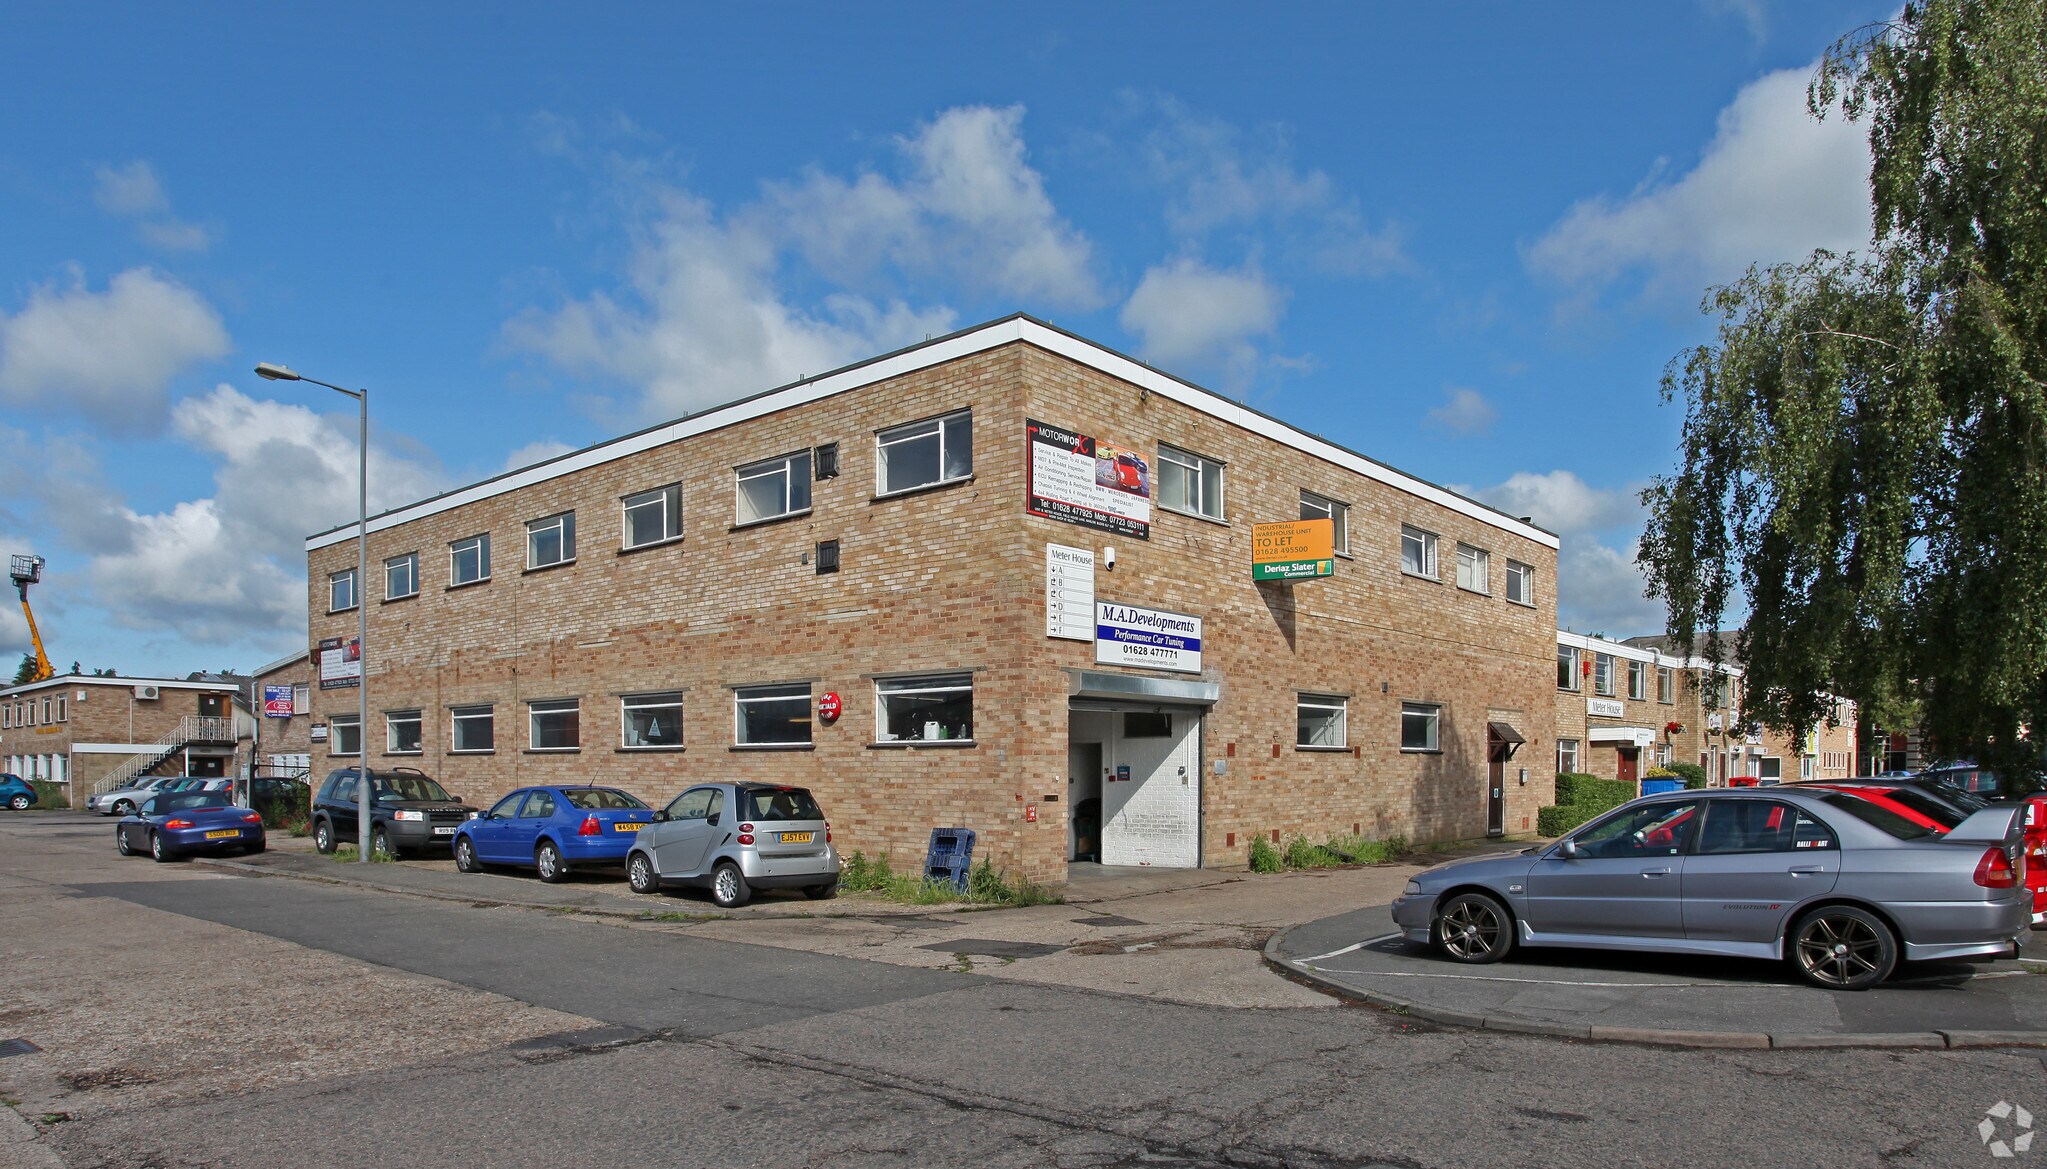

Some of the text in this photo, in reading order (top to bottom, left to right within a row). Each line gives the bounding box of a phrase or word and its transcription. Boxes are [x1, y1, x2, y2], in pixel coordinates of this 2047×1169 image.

[1038, 447, 1052, 456] Service
[1057, 453, 1068, 461] Repair
[1045, 466, 1066, 477] Conditioning
[1068, 464, 1085, 474] Inspection
[1048, 475, 1068, 486] Remapping
[1038, 481, 1052, 489] Chassis
[1089, 494, 1104, 503] Alignment
[1113, 498, 1134, 508] SPECIALIST
[1040, 498, 1144, 531] Tel: 01628 477925 Mob: 07723 053111
[1256, 536, 1292, 548] TO LET
[1052, 549, 1092, 566] Meter House
[1292, 563, 1315, 572] Slater
[1058, 578, 1063, 586] B
[1058, 590, 1063, 598] C
[1058, 602, 1063, 610] D
[1058, 614, 1063, 622] E
[1102, 606, 1194, 632] M.A.Developments
[1114, 629, 1184, 650] Performance Car Tuning
[1123, 645, 1178, 659] 01628 477771
[1124, 656, 1178, 666] www.madevelopments.com
[1592, 701, 1621, 714] Meter House
